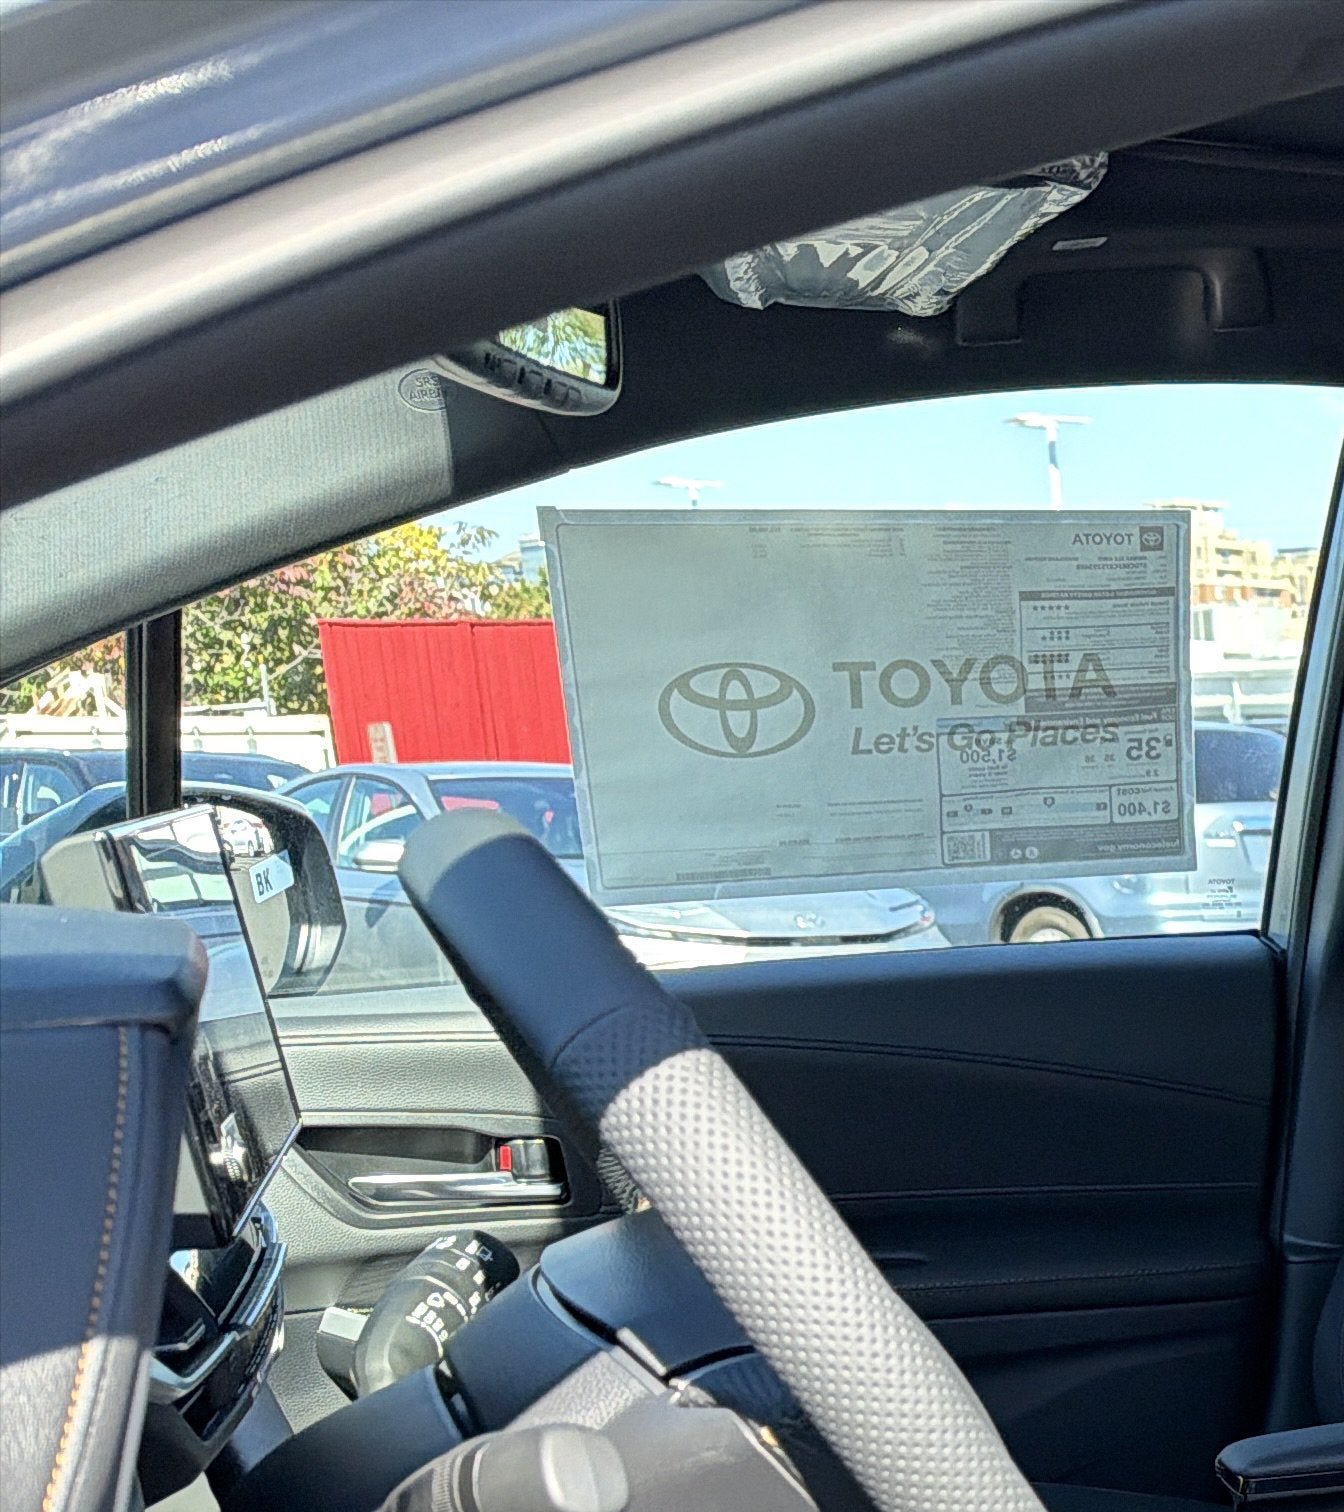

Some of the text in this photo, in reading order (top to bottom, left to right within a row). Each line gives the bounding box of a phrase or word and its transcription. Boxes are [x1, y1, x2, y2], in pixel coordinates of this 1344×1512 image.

[416, 375, 440, 387] SRS
[832, 652, 1118, 709] TOYOTA
[851, 719, 1119, 755] Let's Go Places
[255, 867, 273, 896] BK
